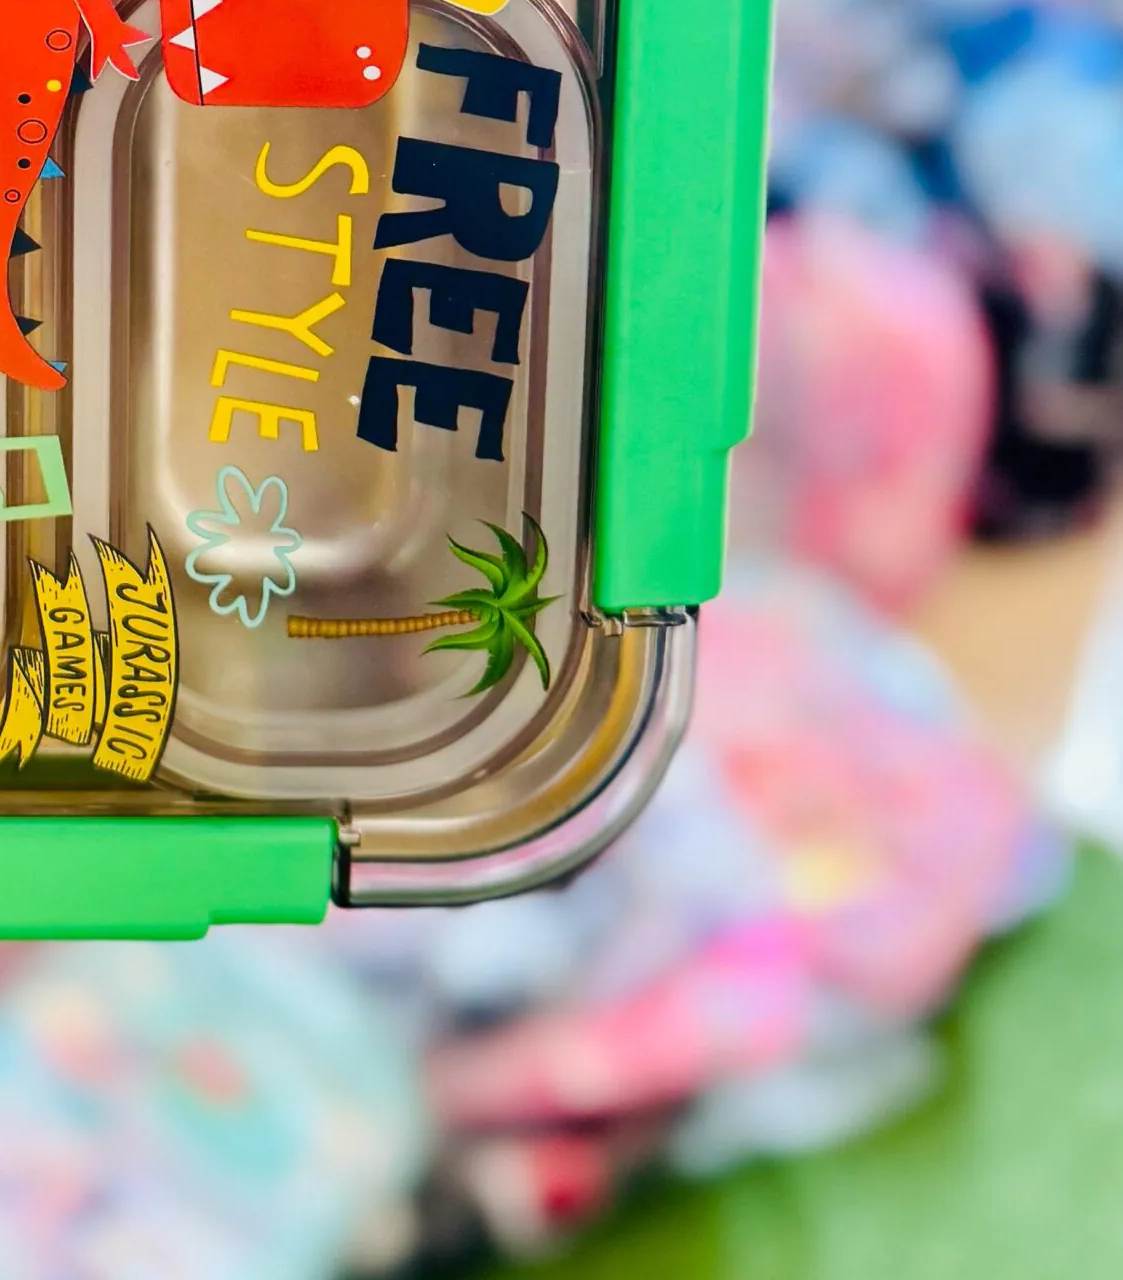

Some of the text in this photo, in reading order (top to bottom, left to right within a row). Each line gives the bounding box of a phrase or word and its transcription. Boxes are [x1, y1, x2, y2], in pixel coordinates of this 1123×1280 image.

[209, 141, 369, 451] STYLE
[357, 42, 562, 461] FREE
[48, 606, 87, 712] GAMES
[107, 583, 171, 760] JURASSIC
